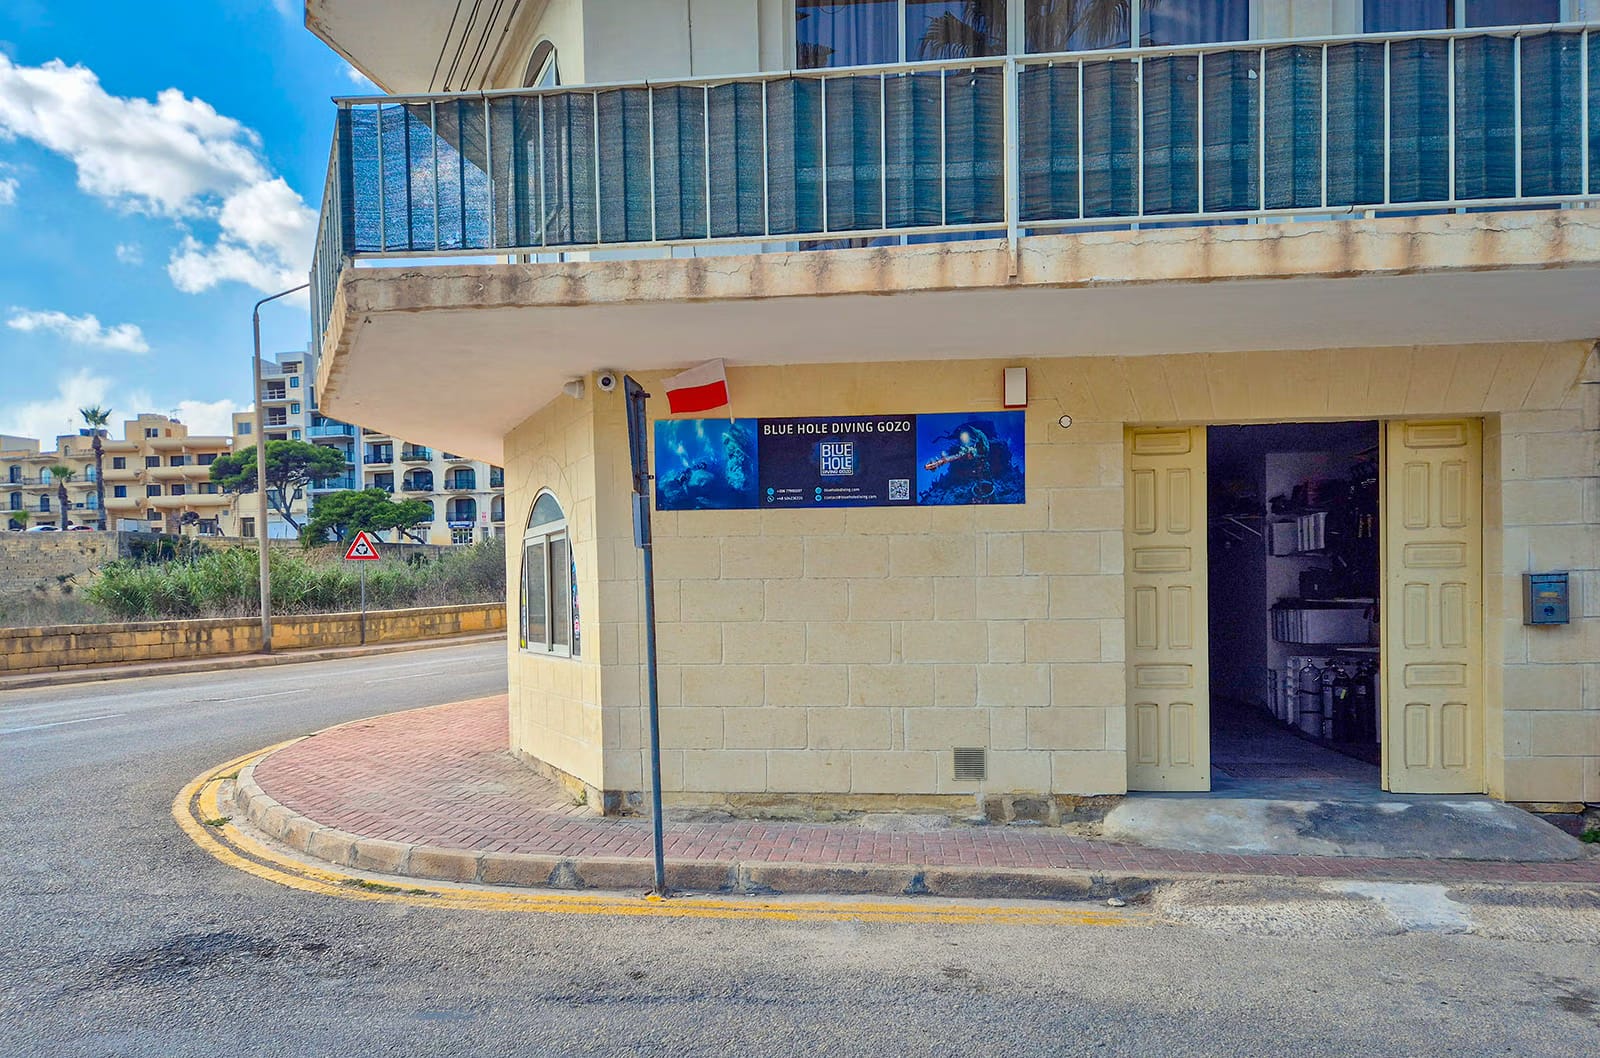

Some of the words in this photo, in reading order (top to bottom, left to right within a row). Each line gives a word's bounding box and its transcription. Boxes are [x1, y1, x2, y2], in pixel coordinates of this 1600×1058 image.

[763, 424, 793, 435] BLUE
[797, 423, 828, 434] HOLE
[832, 422, 873, 434] DIVING
[877, 421, 911, 433] GOZO
[822, 443, 852, 457] BLUE
[822, 457, 852, 470] HOLE
